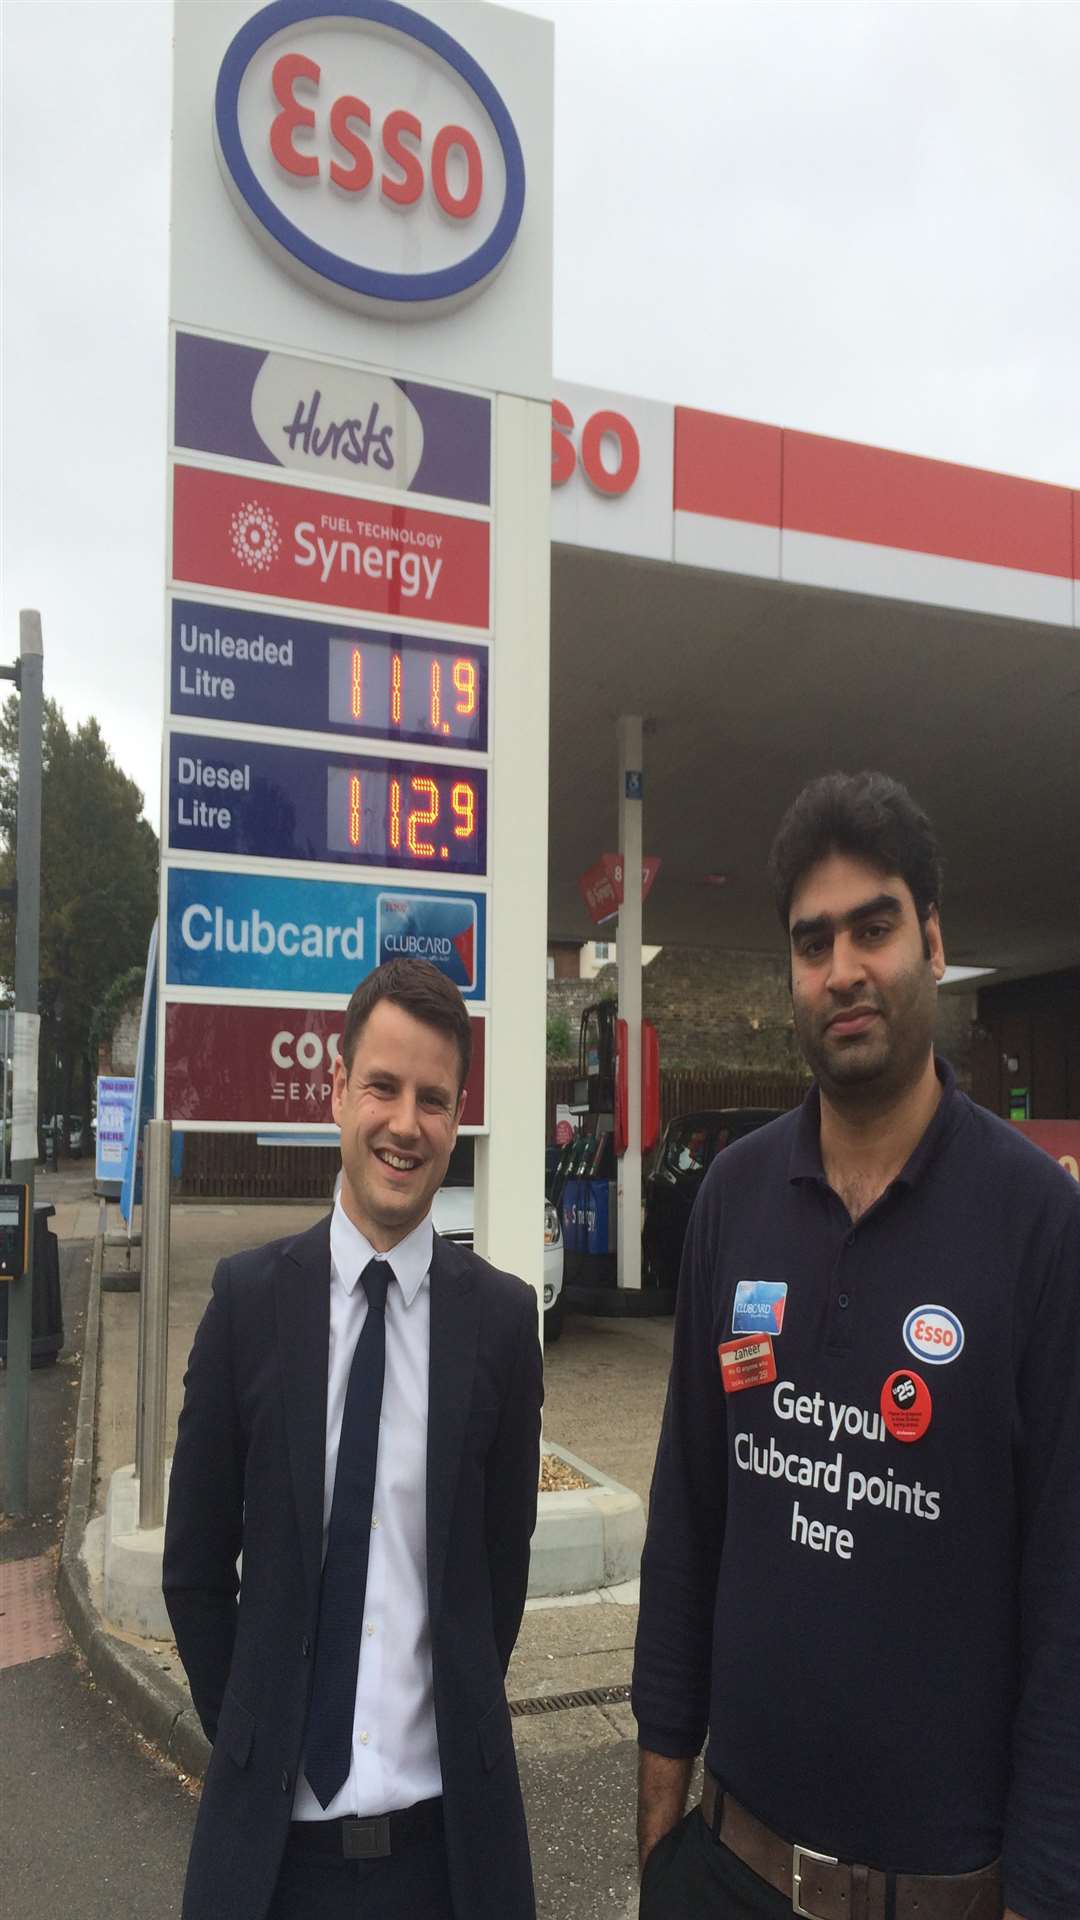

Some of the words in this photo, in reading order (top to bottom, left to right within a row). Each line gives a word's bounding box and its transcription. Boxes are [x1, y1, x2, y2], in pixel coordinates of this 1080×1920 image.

[270, 53, 483, 220] ESSO
[284, 390, 395, 470] Hursts
[552, 399, 640, 496] SO
[320, 514, 353, 534] FUEL
[357, 521, 443, 550] TECHNOLOGY
[294, 522, 443, 601] Synergy
[180, 623, 294, 667] Unleaded
[179, 666, 236, 701] Litre
[350, 648, 477, 736] 111.9
[178, 756, 250, 792] Diesel
[177, 799, 232, 830] Litre
[348, 776, 475, 859] 112.9
[180, 903, 365, 962] Clubcard
[383, 933, 452, 956] CLUBCARD
[271, 1030, 340, 1074] COS
[736, 1303, 771, 1314] CLUBCARD
[734, 1343, 762, 1361] Zaheer
[914, 1318, 955, 1348] ESSO
[773, 1381, 825, 1427] Get
[734, 1432, 843, 1494] Clubcard
[846, 1468, 942, 1521] points
[790, 1501, 854, 1560] here
